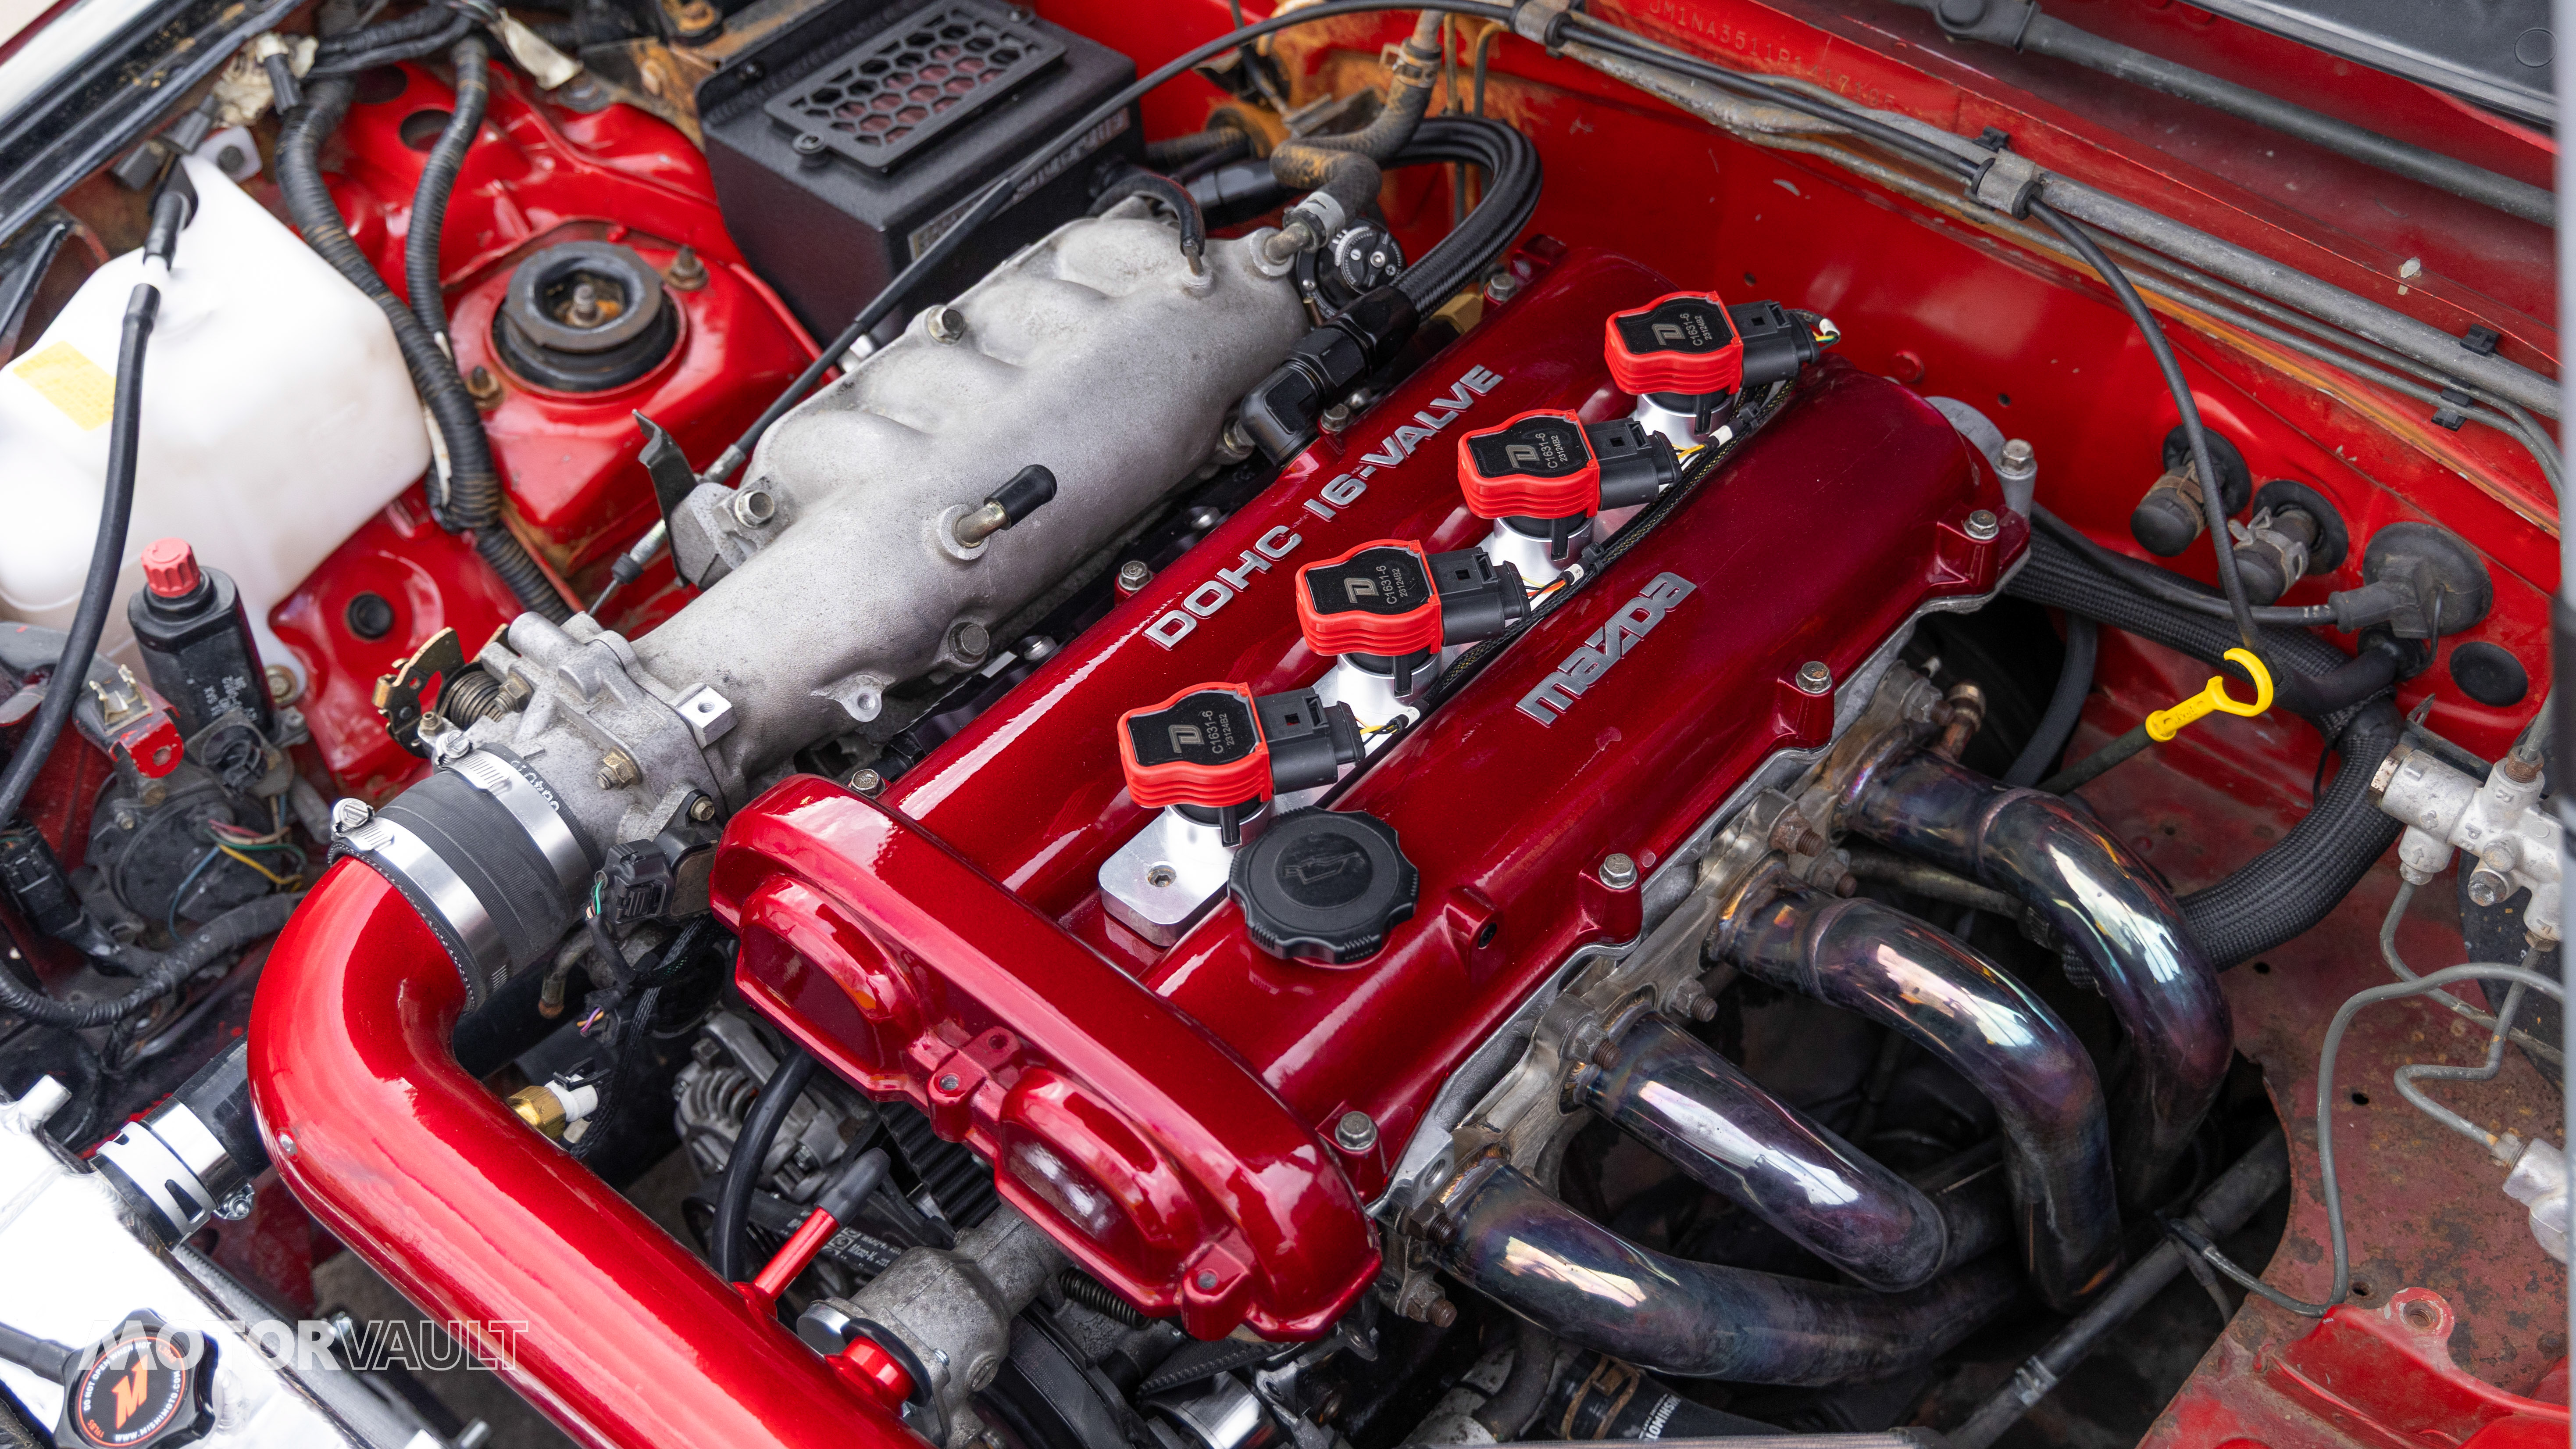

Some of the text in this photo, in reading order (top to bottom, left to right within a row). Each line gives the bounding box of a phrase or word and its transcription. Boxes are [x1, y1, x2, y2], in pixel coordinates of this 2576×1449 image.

[1680, 313, 1703, 346] C1631-6
[1695, 315, 1712, 340] 23124B2
[1535, 433, 1558, 469] C1631-6
[1551, 435, 1568, 462] 23124B2
[1142, 525, 1302, 650] DOHC
[1376, 565, 1397, 605] C1631-6
[1392, 568, 1408, 597] 23124B2
[1515, 572, 1698, 727] mazda
[1202, 710, 1224, 754] C1631-6
[1219, 713, 1235, 746] 23124B2
[110, 1344, 134, 1360] WHEN
[92, 1358, 110, 1380] OPEN
[83, 1399, 91, 1411] DO
[86, 1382, 96, 1398] NOT
[115, 1370, 181, 1442] WWW.MISHIMOTO.COM
[88, 1419, 105, 1438] 19LBS
